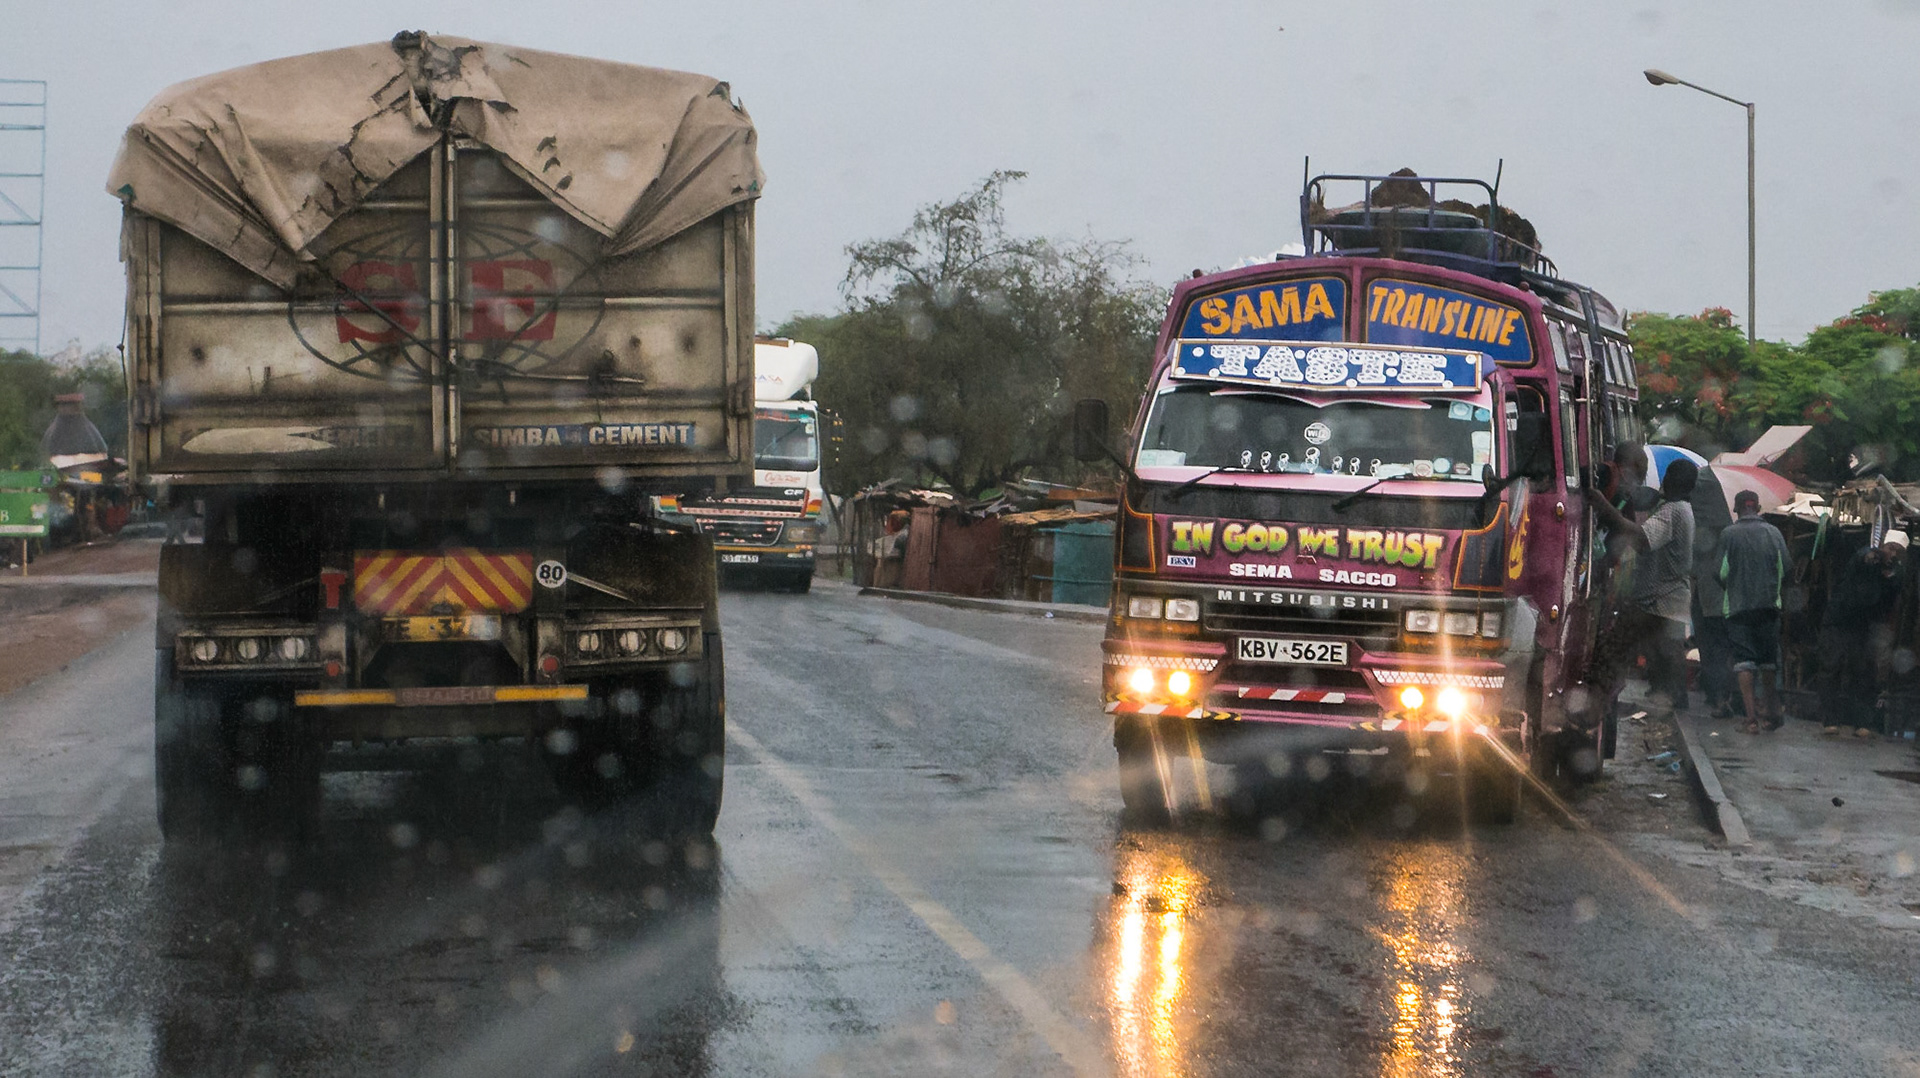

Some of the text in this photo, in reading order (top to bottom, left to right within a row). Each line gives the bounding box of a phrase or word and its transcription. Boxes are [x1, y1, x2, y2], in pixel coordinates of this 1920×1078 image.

[1200, 283, 1335, 335] SAMA
[1370, 286, 1519, 346] TRANSLINE
[1210, 345, 1447, 384] TASTE
[474, 425, 690, 447] SIMBA CEMENT
[1172, 521, 1445, 569] IN GOD WE TRUST
[539, 564, 563, 581] 80
[1229, 563, 1397, 587] SEMA SACCO
[1217, 589, 1389, 610] MITSUBISHI
[1240, 639, 1343, 663] KBV 562E
